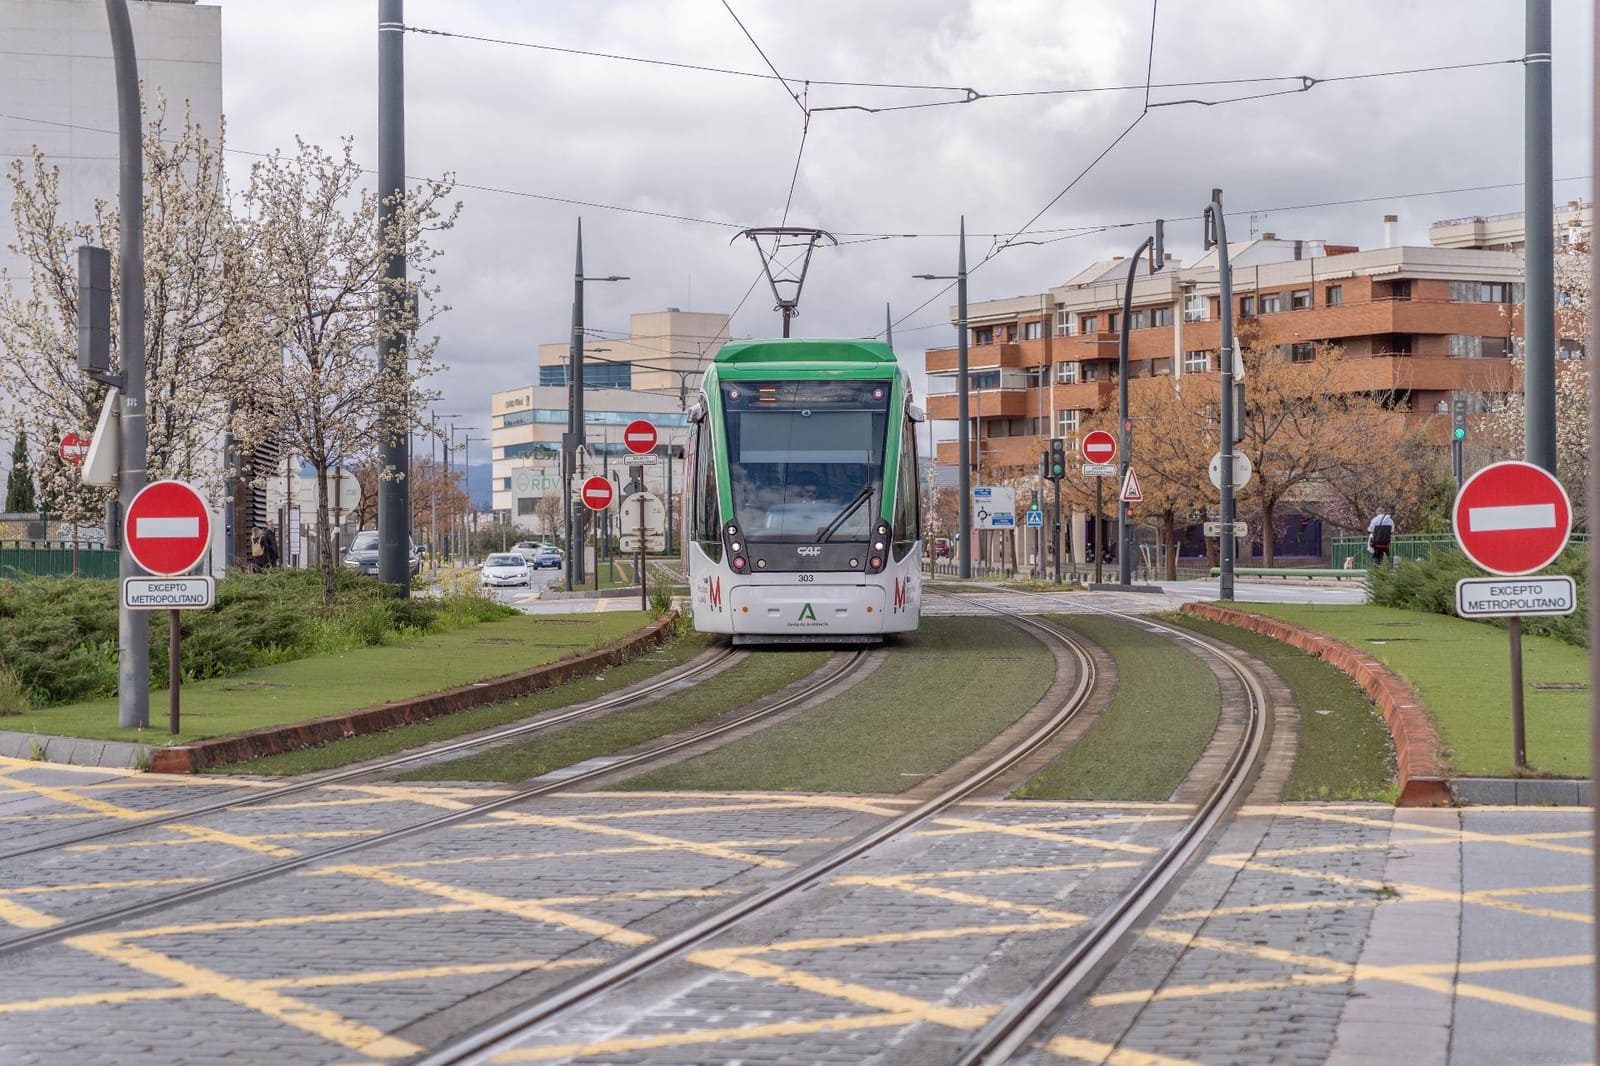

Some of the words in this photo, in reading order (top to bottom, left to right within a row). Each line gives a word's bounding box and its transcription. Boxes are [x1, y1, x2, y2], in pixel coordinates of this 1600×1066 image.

[798, 574, 814, 582] 303
[148, 583, 187, 592] EXCEPTO
[1490, 585, 1542, 596] EXCEPTO
[131, 595, 204, 604] METROPOLITANO
[1468, 597, 1566, 610] METROPOLITANO
